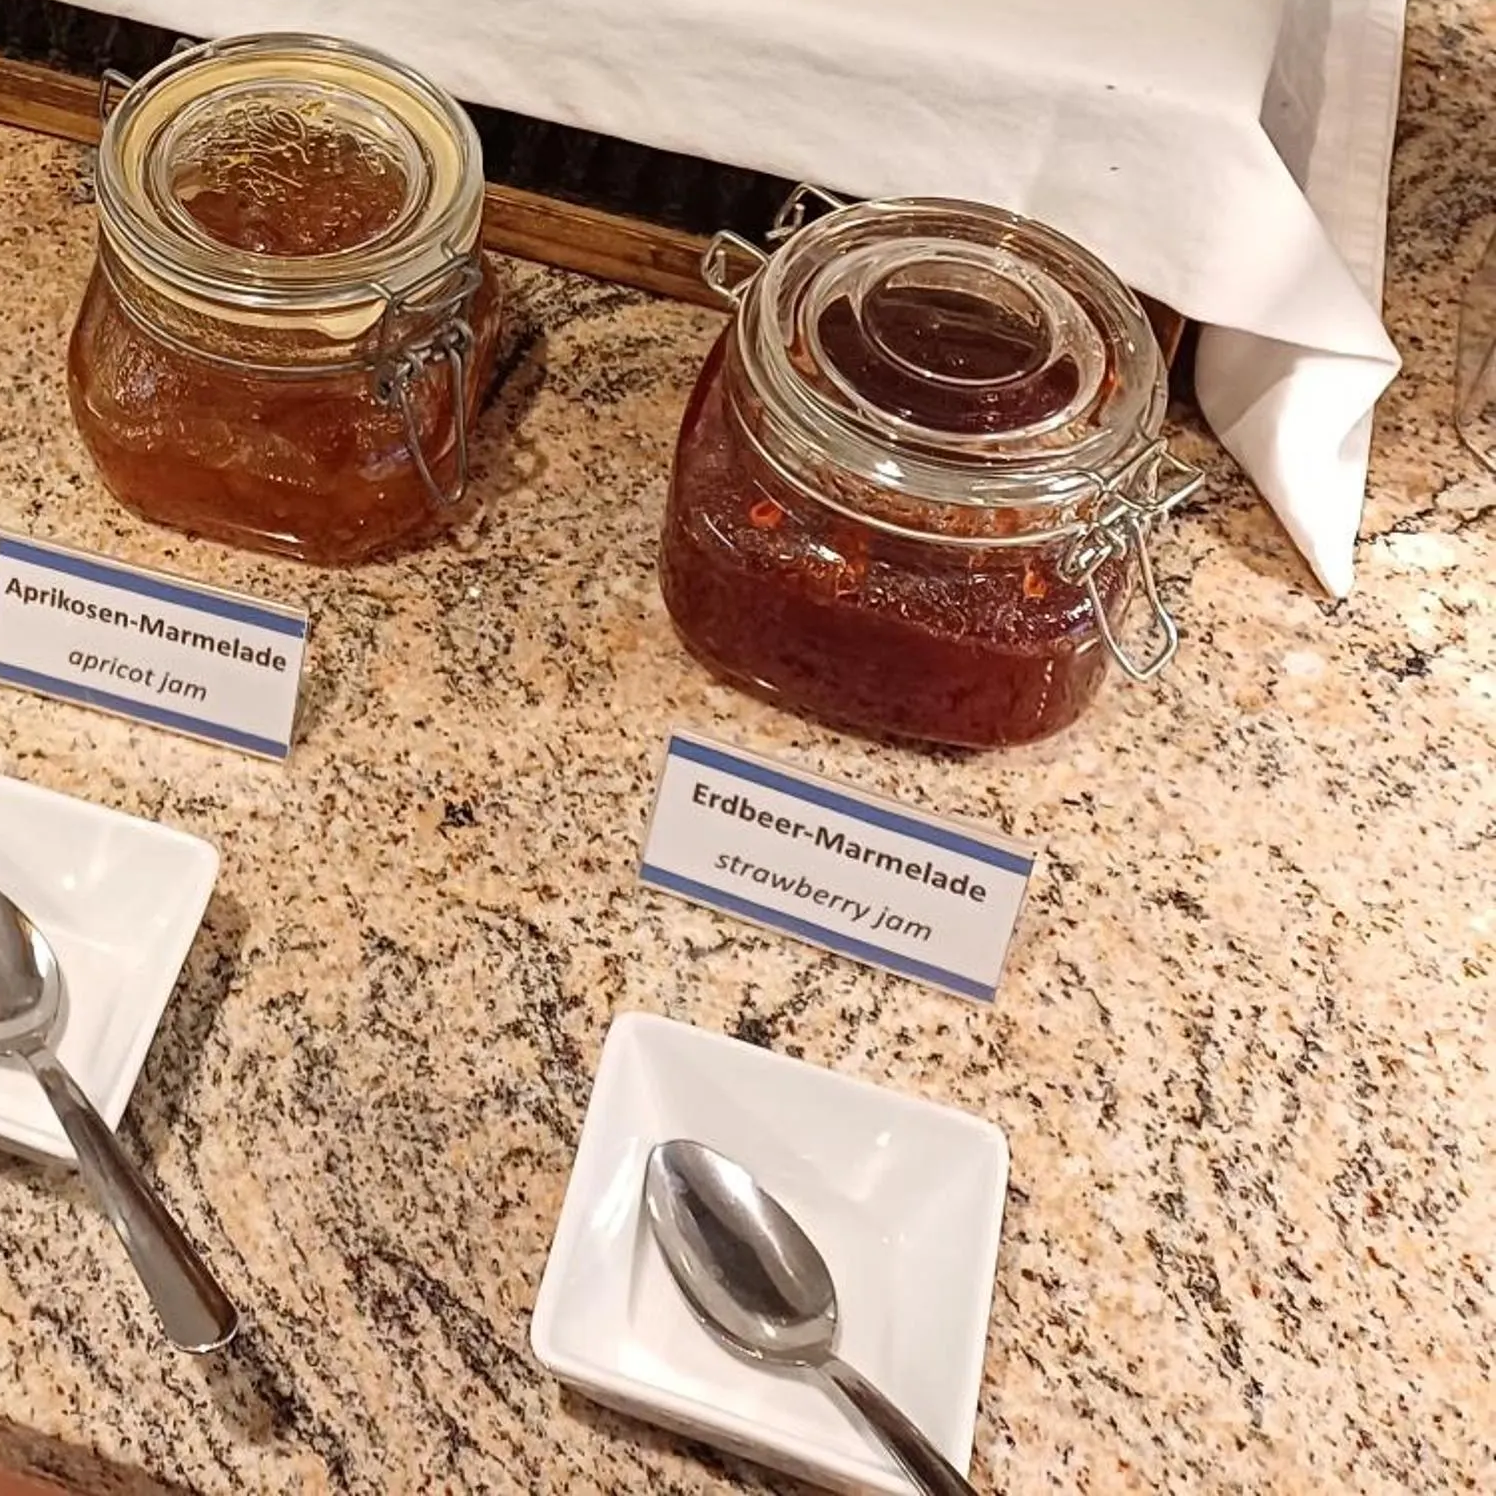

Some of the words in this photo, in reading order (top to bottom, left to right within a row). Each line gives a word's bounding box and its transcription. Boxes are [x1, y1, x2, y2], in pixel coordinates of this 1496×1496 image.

[4, 577, 287, 673] Aprikosen-Marmelade
[68, 651, 156, 687] apricot
[157, 671, 207, 702] jam
[692, 782, 988, 904] Erdbeer-Marmelade
[714, 851, 872, 924] strawberry
[873, 906, 933, 942] jam
